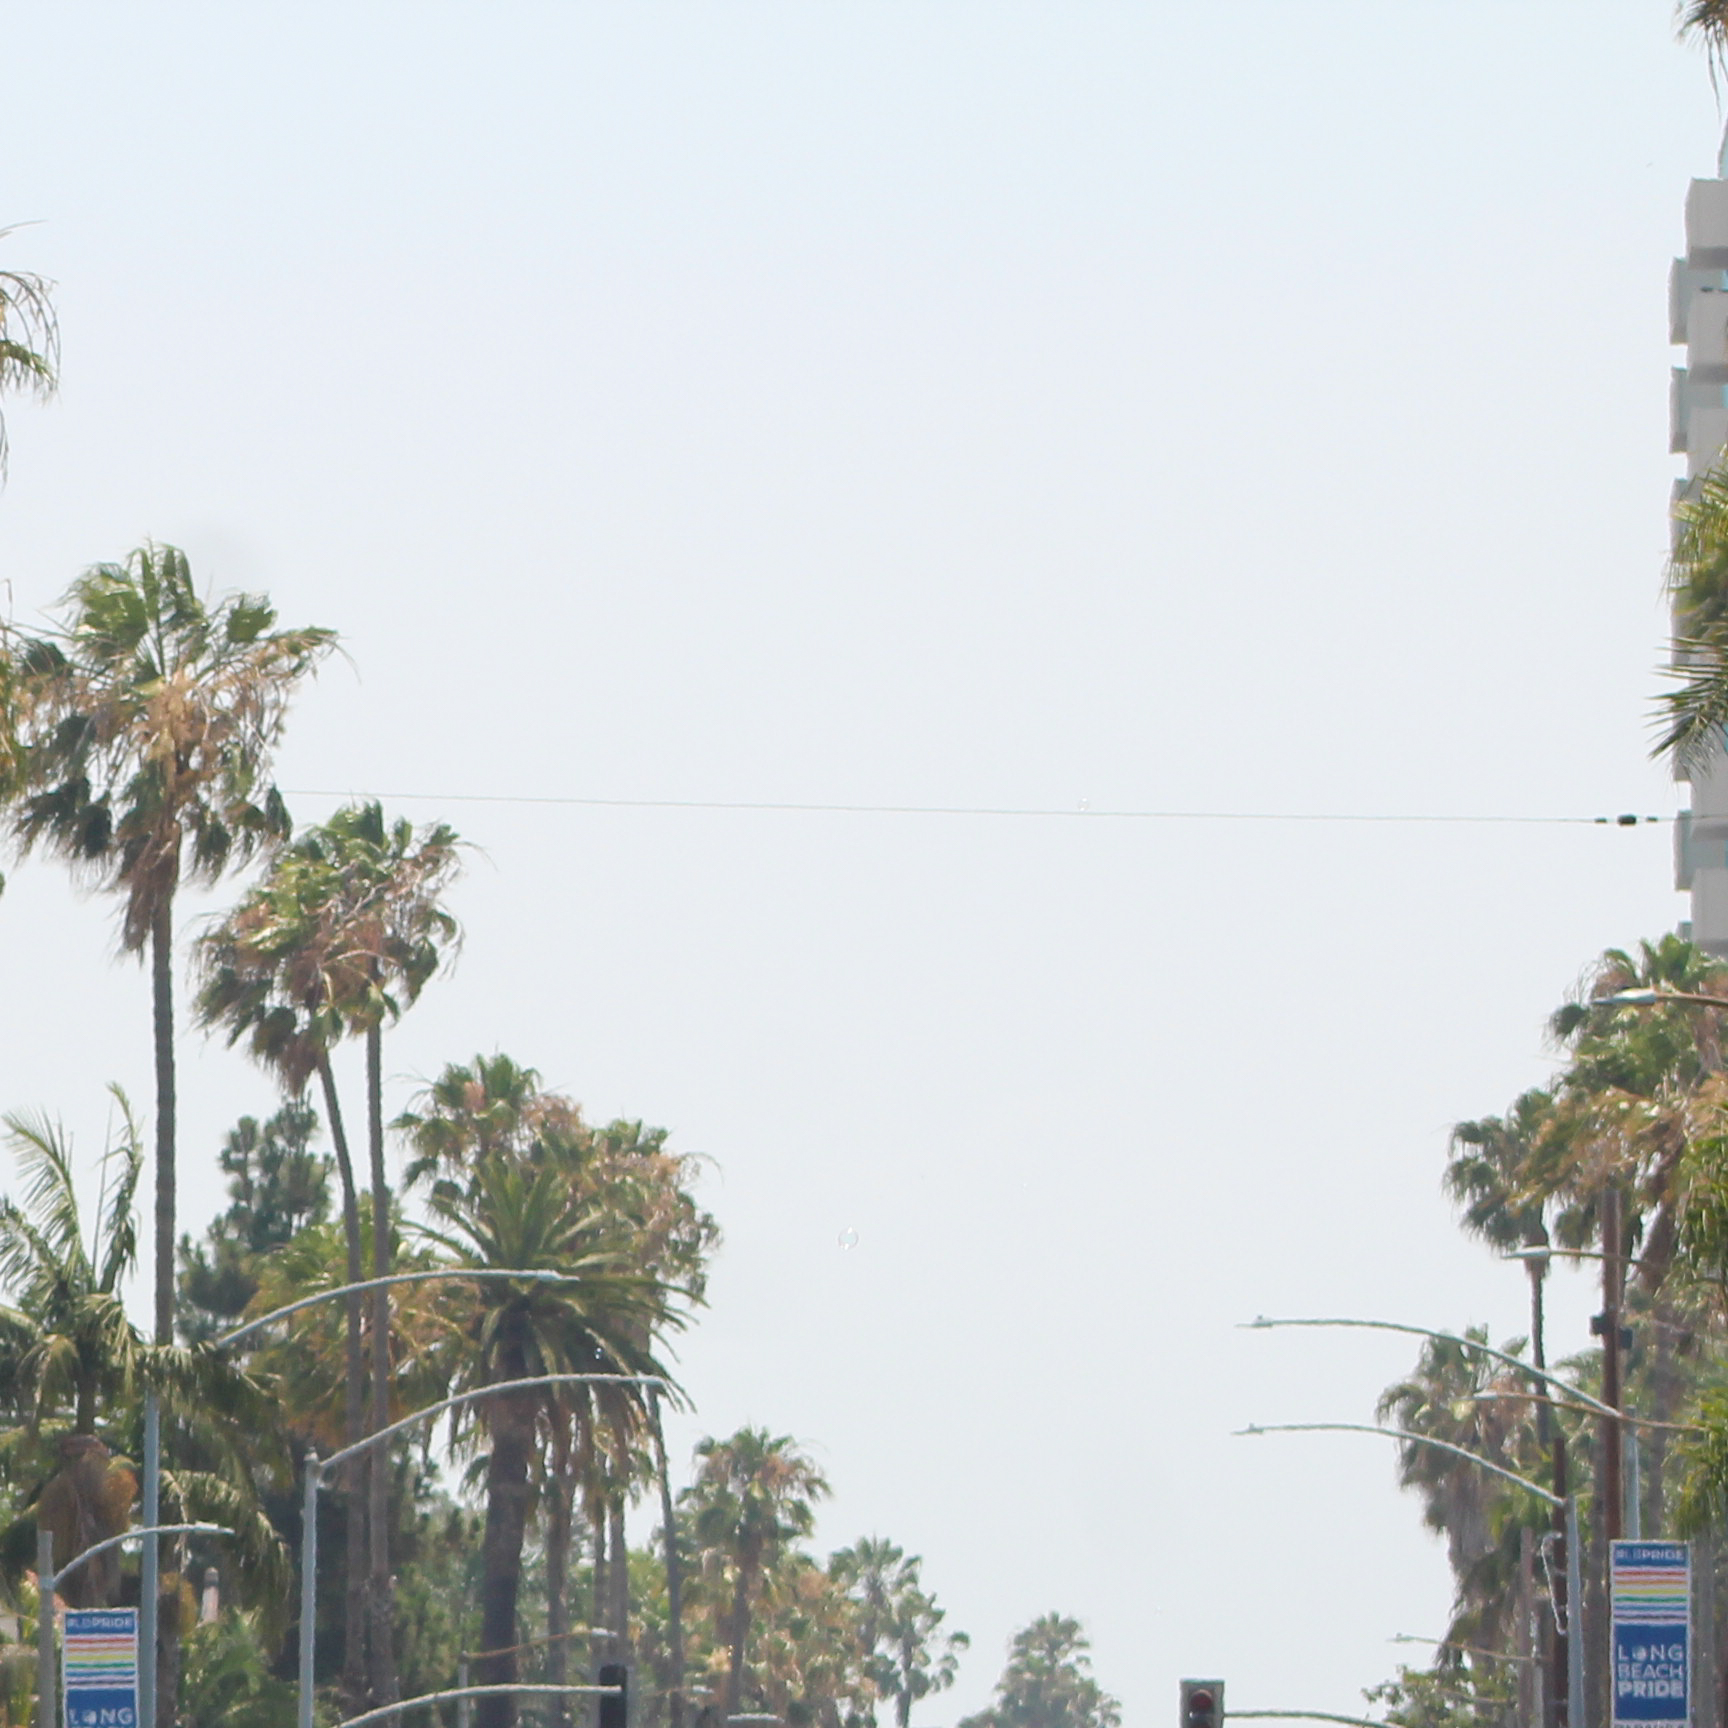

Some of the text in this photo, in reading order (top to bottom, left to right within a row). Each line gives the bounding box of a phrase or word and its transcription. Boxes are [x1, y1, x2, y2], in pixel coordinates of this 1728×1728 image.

[1617, 1644, 1684, 1661] LONG
[1617, 1664, 1684, 1679] BEACH
[1618, 1680, 1684, 1698] PRIDE
[69, 1707, 133, 1725] LONG
